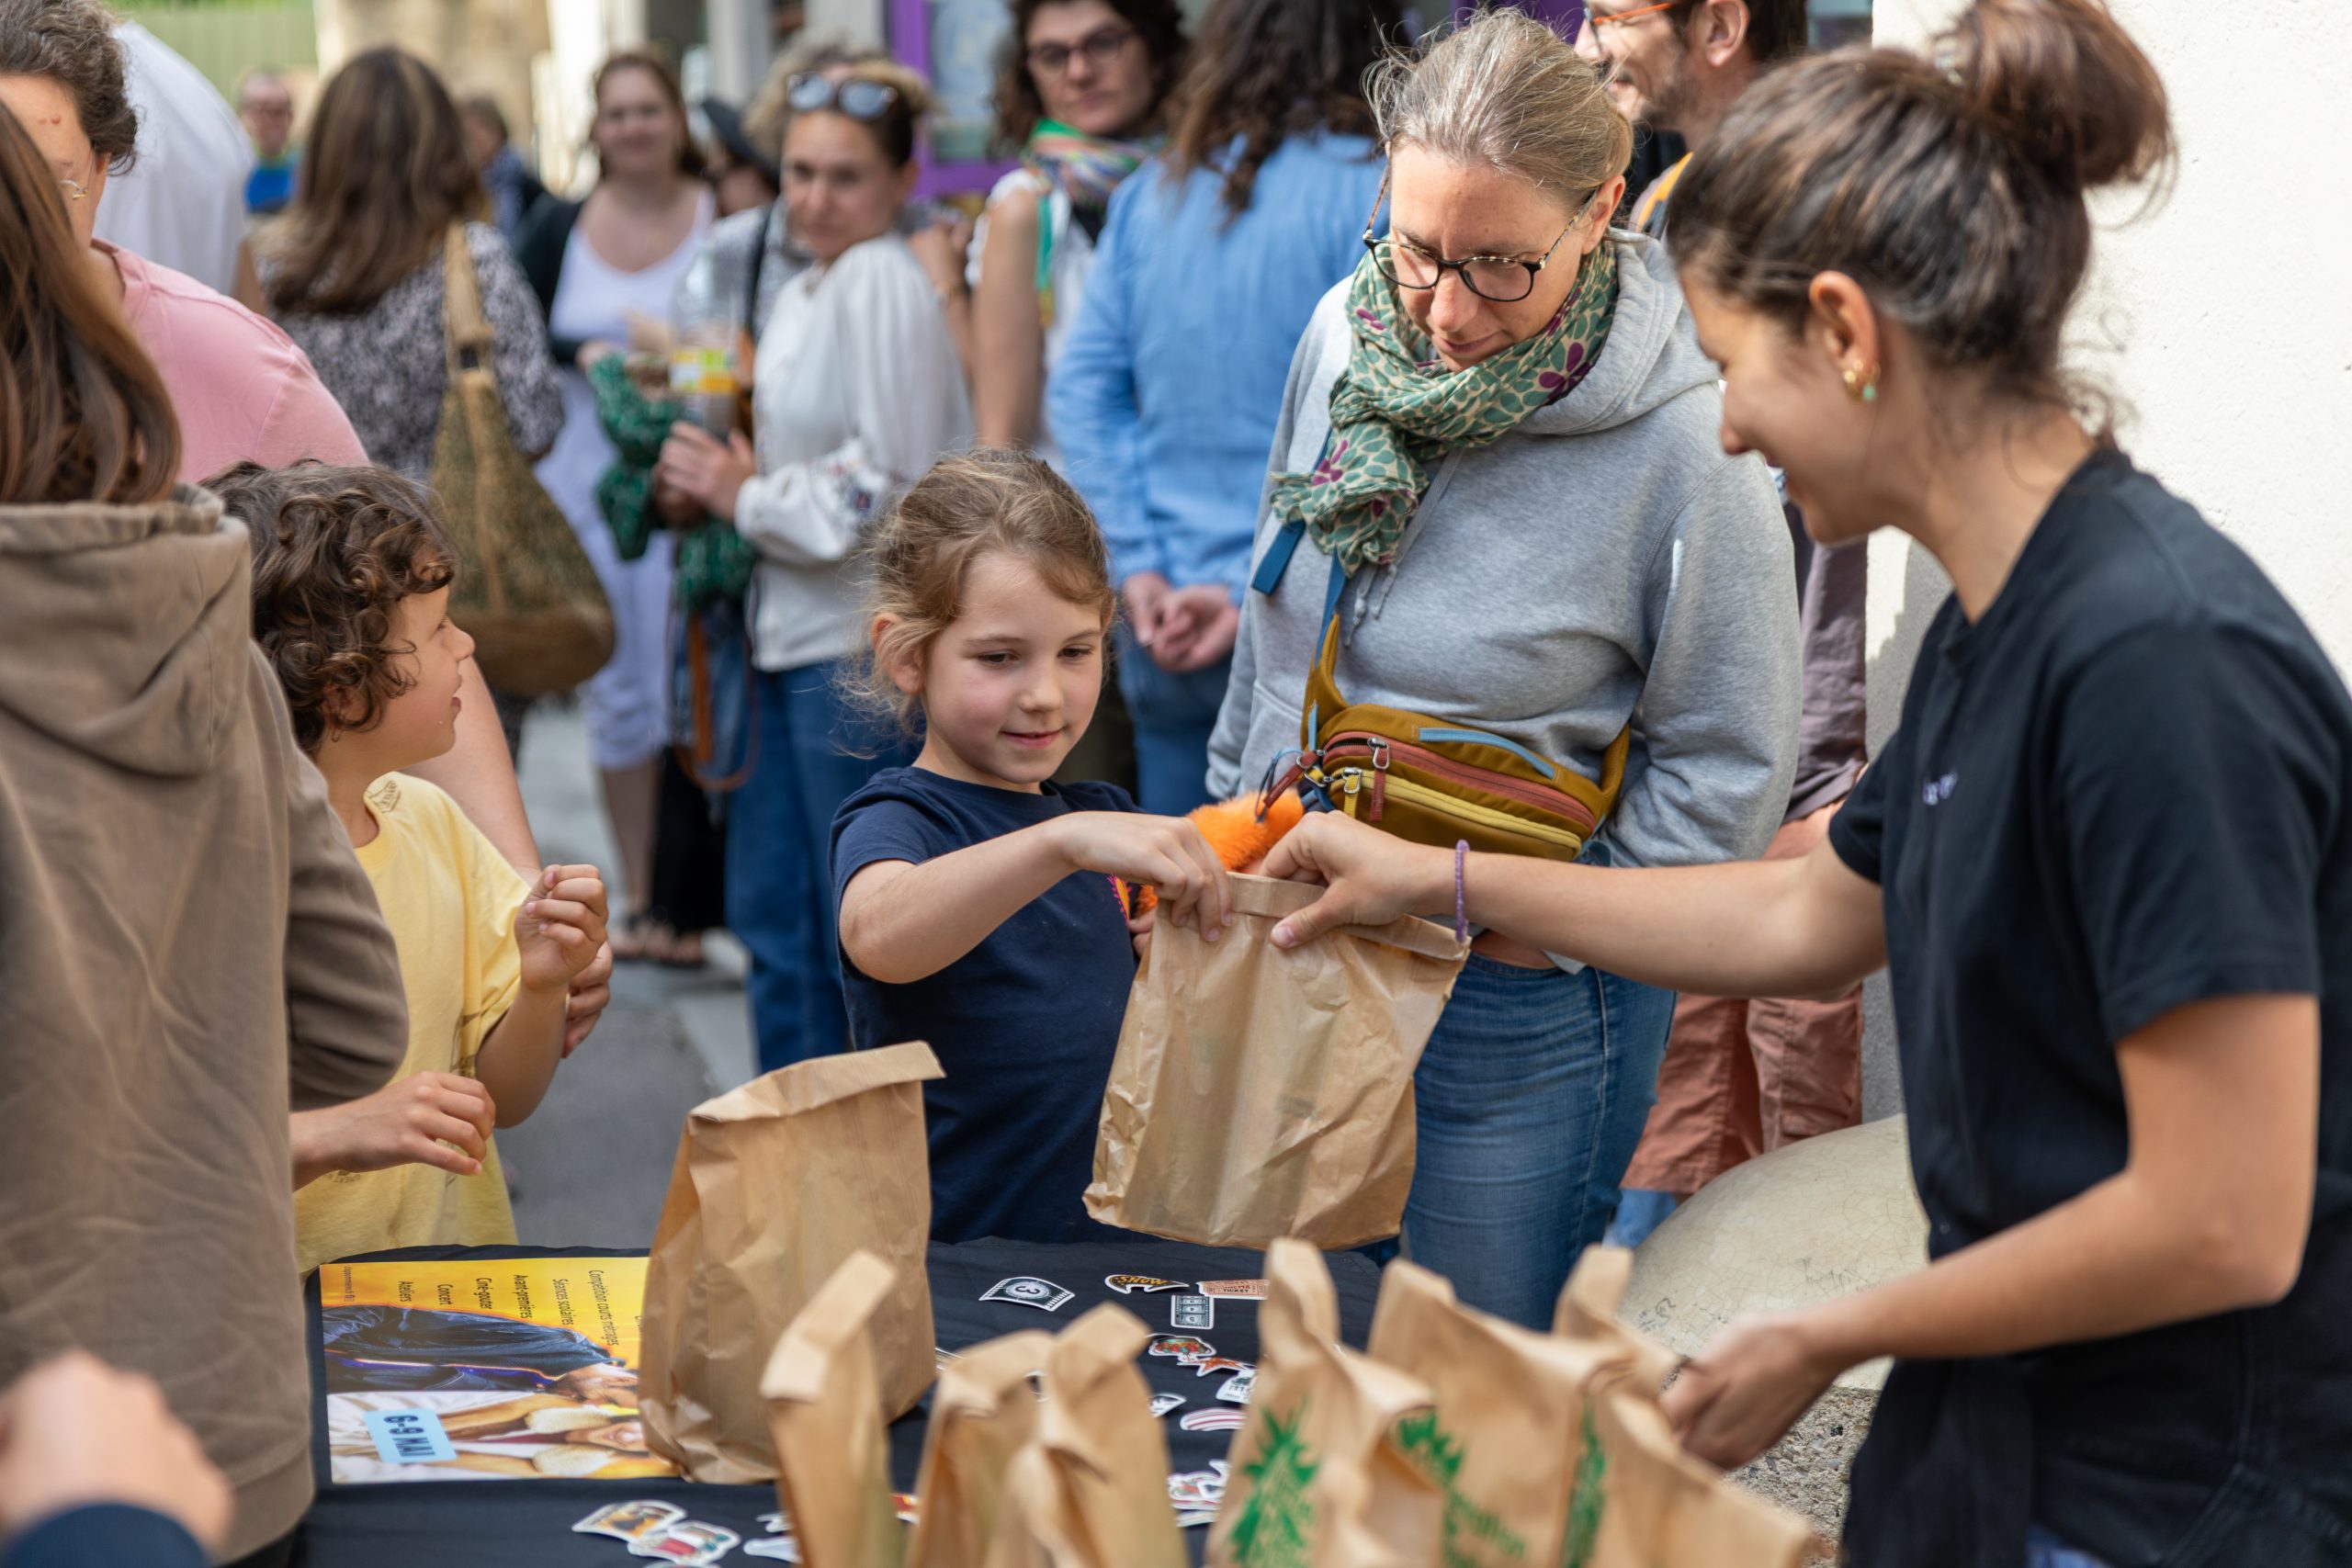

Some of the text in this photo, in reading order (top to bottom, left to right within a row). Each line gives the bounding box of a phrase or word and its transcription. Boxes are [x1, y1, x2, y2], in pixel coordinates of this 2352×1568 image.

[398, 1280, 415, 1302] Ateliers
[436, 1283, 453, 1304] Concert
[512, 1274, 535, 1318] Avant-premières
[1014, 1285, 1041, 1295] 3
[1118, 1276, 1168, 1285] SHOW
[552, 1279, 576, 1325] Séances scolaires
[587, 1269, 619, 1346] Compétition courts métrages
[383, 1416, 435, 1457] 6-9 MAI
